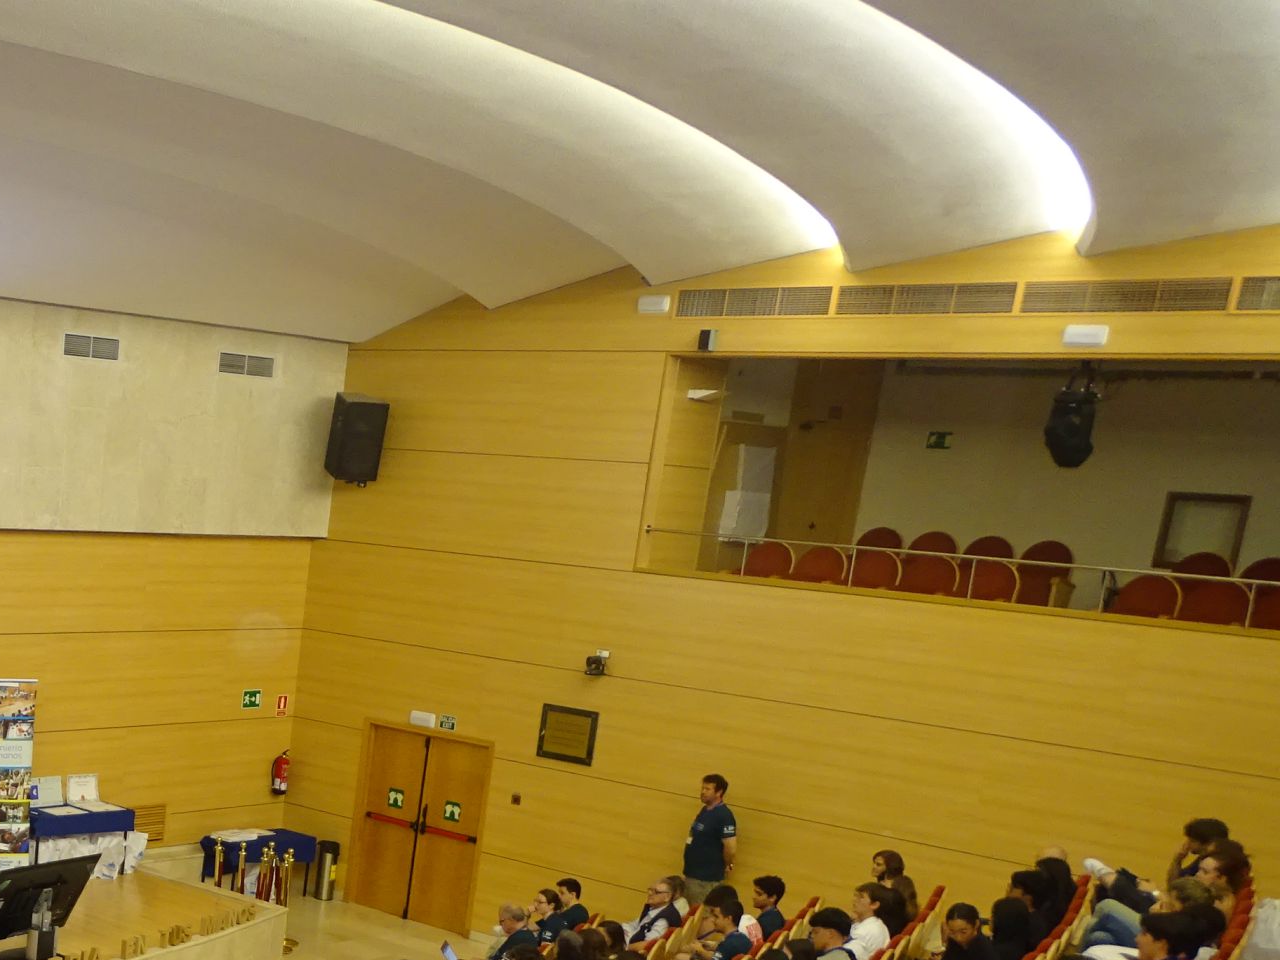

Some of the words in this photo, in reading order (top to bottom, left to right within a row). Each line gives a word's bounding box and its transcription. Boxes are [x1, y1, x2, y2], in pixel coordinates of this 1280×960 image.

[120, 934, 147, 960] EN
[158, 924, 192, 949] TUS
[200, 904, 257, 936] MANOS
